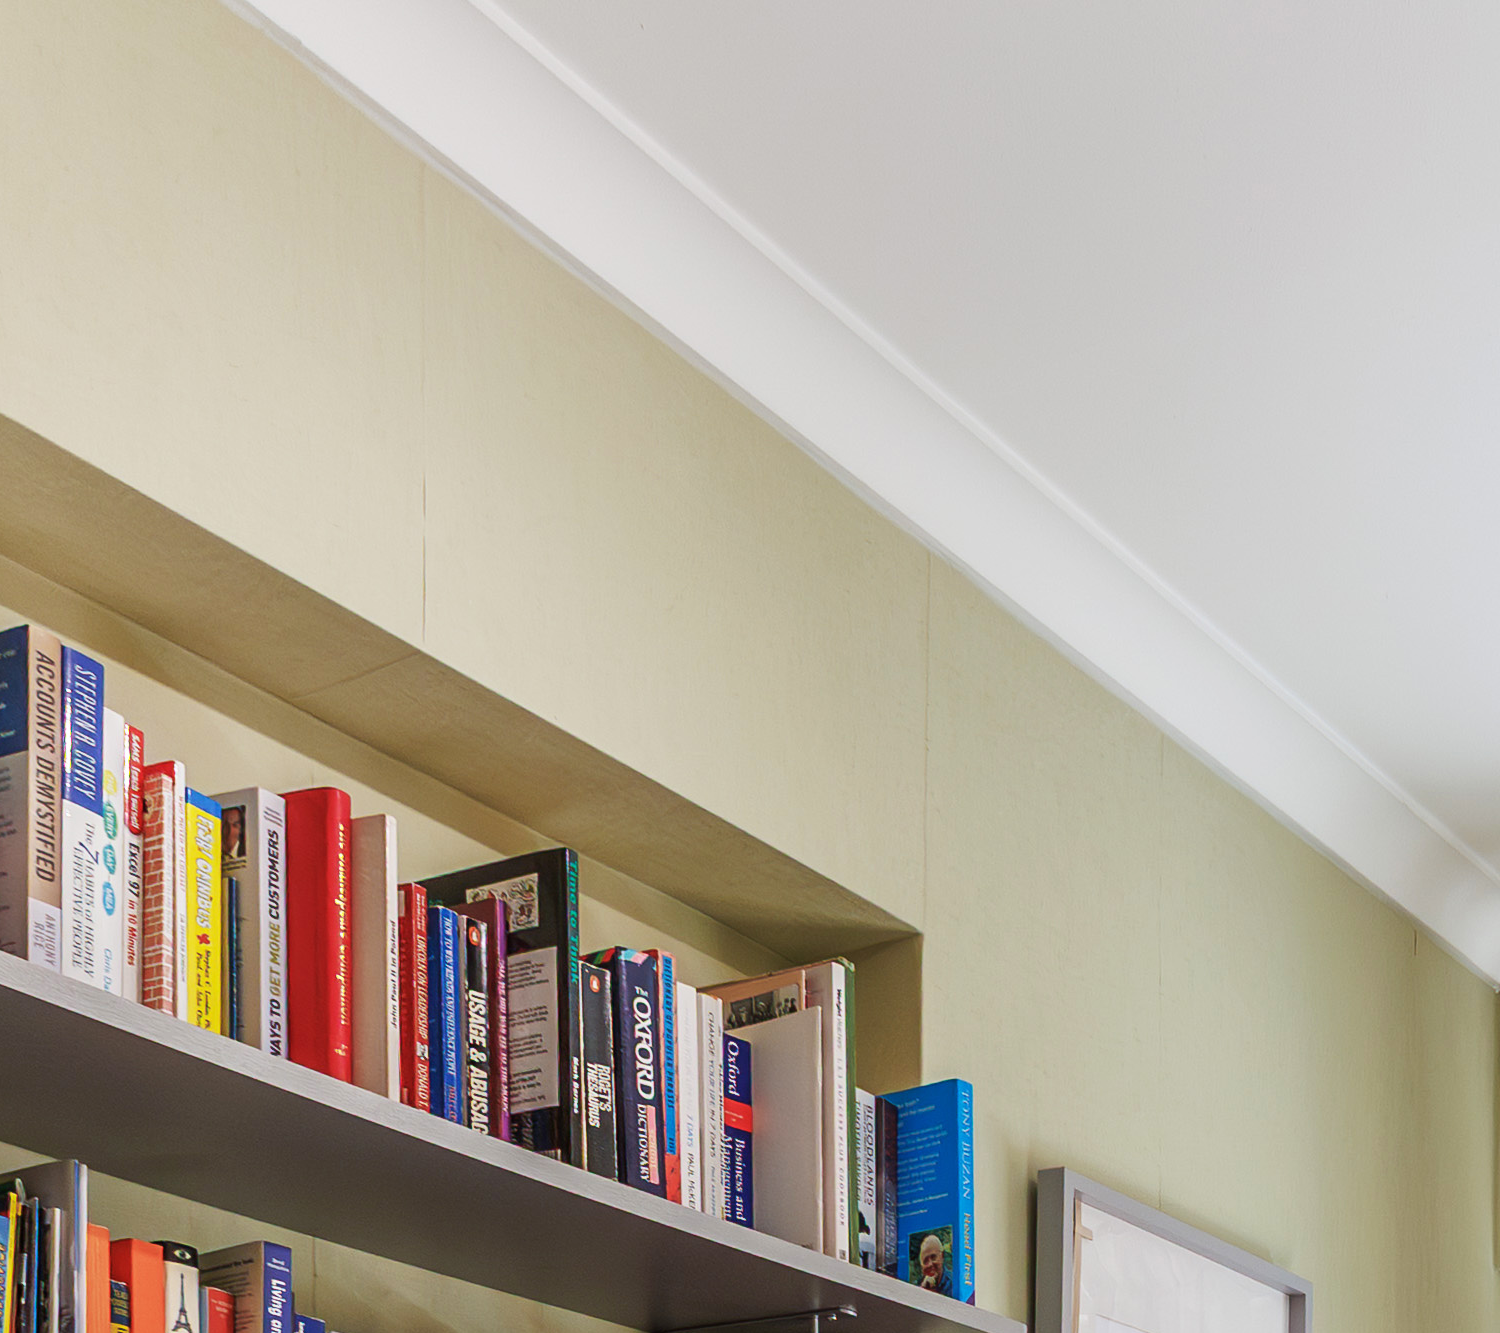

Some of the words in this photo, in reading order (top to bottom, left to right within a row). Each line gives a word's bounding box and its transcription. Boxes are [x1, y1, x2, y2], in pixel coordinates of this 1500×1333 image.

[37, 651, 56, 758] ACCOUNTS
[36, 763, 54, 882] DEMYSTIFIED
[33, 923, 45, 950] RICE
[42, 914, 56, 966] ANTHONY
[726, 1041, 739, 1097] Oxford
[961, 1091, 971, 1137] TONY
[637, 1104, 650, 1183] DICTIONARY
[733, 1137, 746, 1193] Business
[866, 1105, 875, 1206] BLOODLANDS
[962, 1141, 971, 1200] BUZAN
[735, 1195, 747, 1220] and
[268, 1279, 287, 1316] Living
